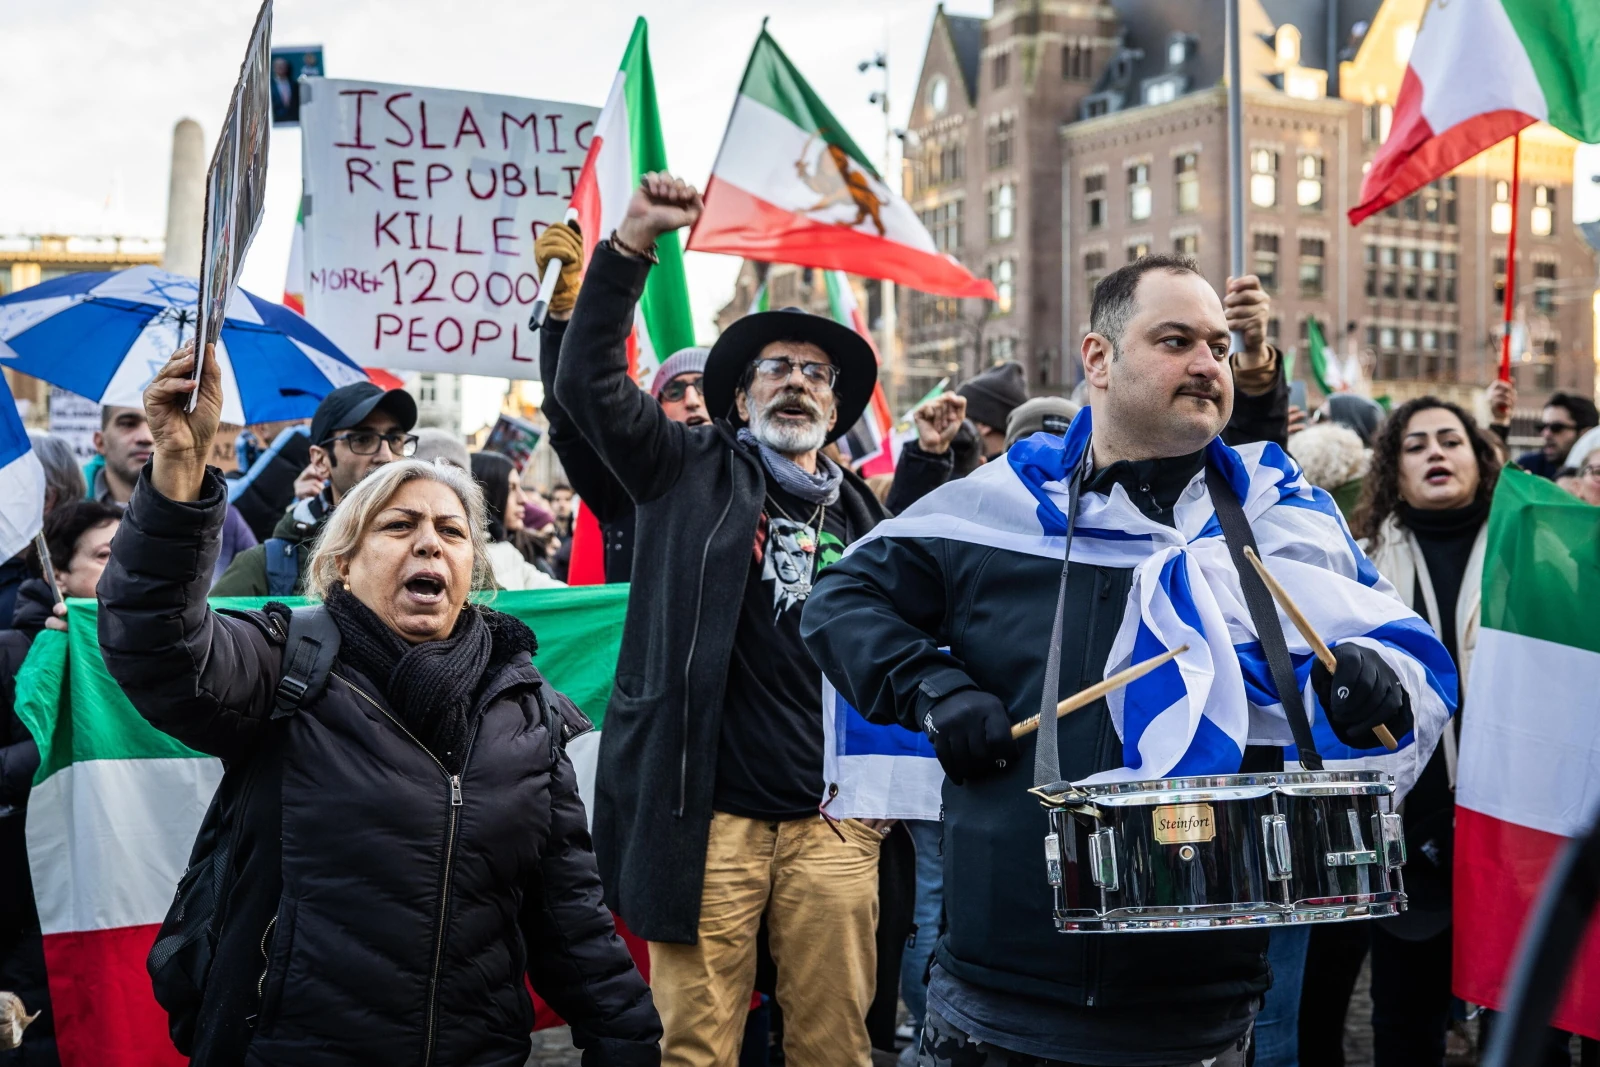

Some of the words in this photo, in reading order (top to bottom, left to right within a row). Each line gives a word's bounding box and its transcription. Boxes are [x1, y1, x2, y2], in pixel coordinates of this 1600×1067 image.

[333, 89, 594, 154] ISLAMIC
[345, 156, 583, 200] REPUBLI
[380, 257, 541, 307] 12000
[374, 312, 533, 363] PEOPL
[1158, 815, 1211, 833] Steinfort
